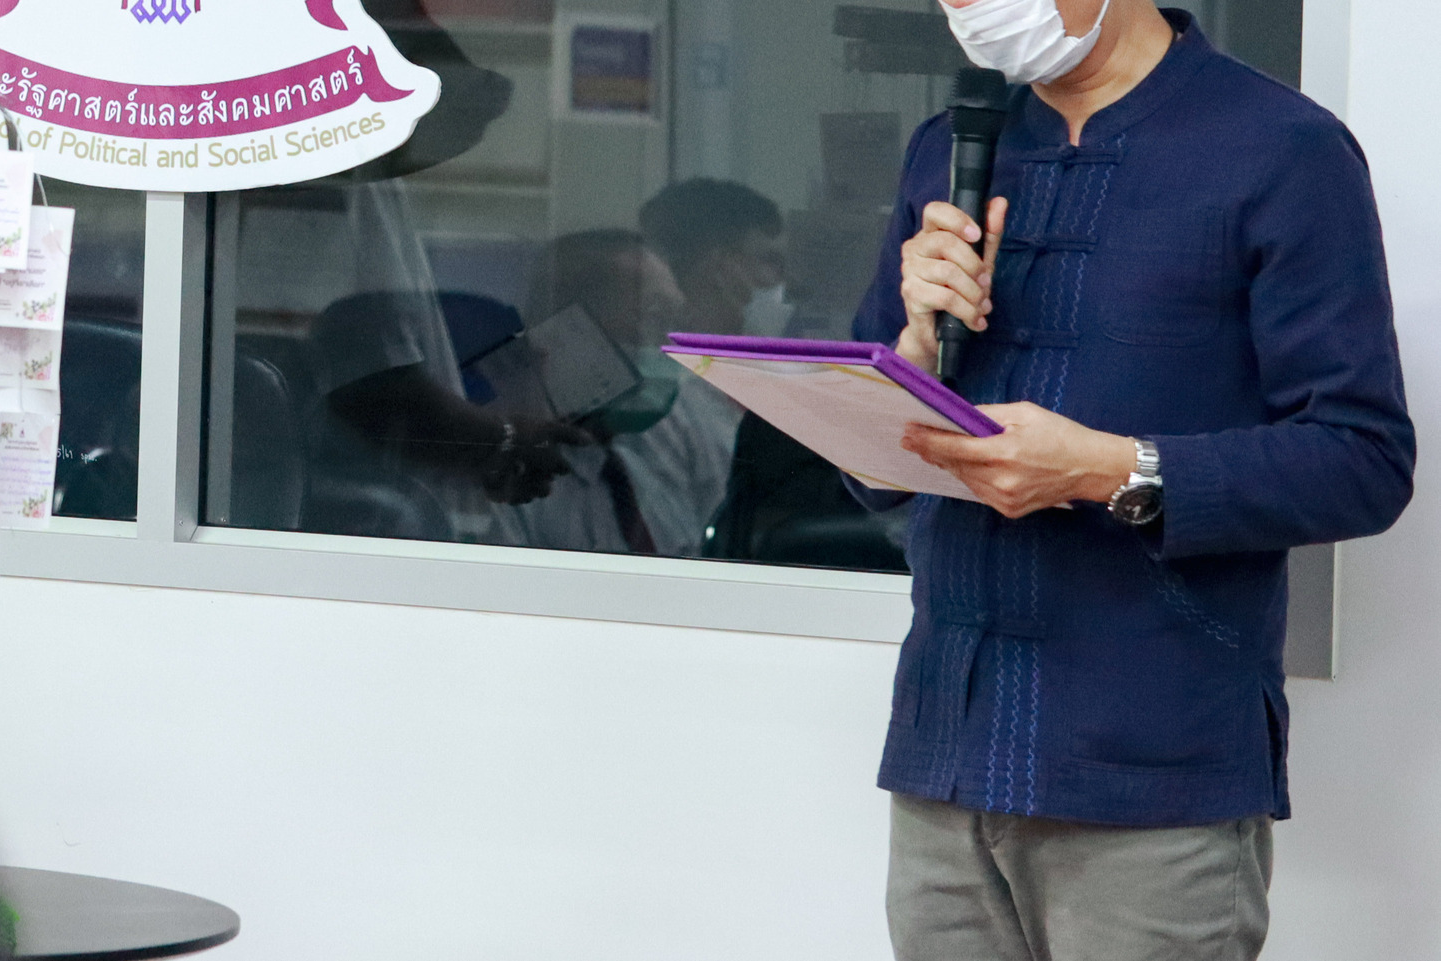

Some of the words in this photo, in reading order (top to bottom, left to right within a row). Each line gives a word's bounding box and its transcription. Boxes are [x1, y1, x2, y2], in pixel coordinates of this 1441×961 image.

[28, 127, 53, 151] of
[59, 131, 147, 167] Political
[157, 143, 198, 168] and
[208, 135, 278, 168] Social
[286, 112, 386, 157] Sciences
